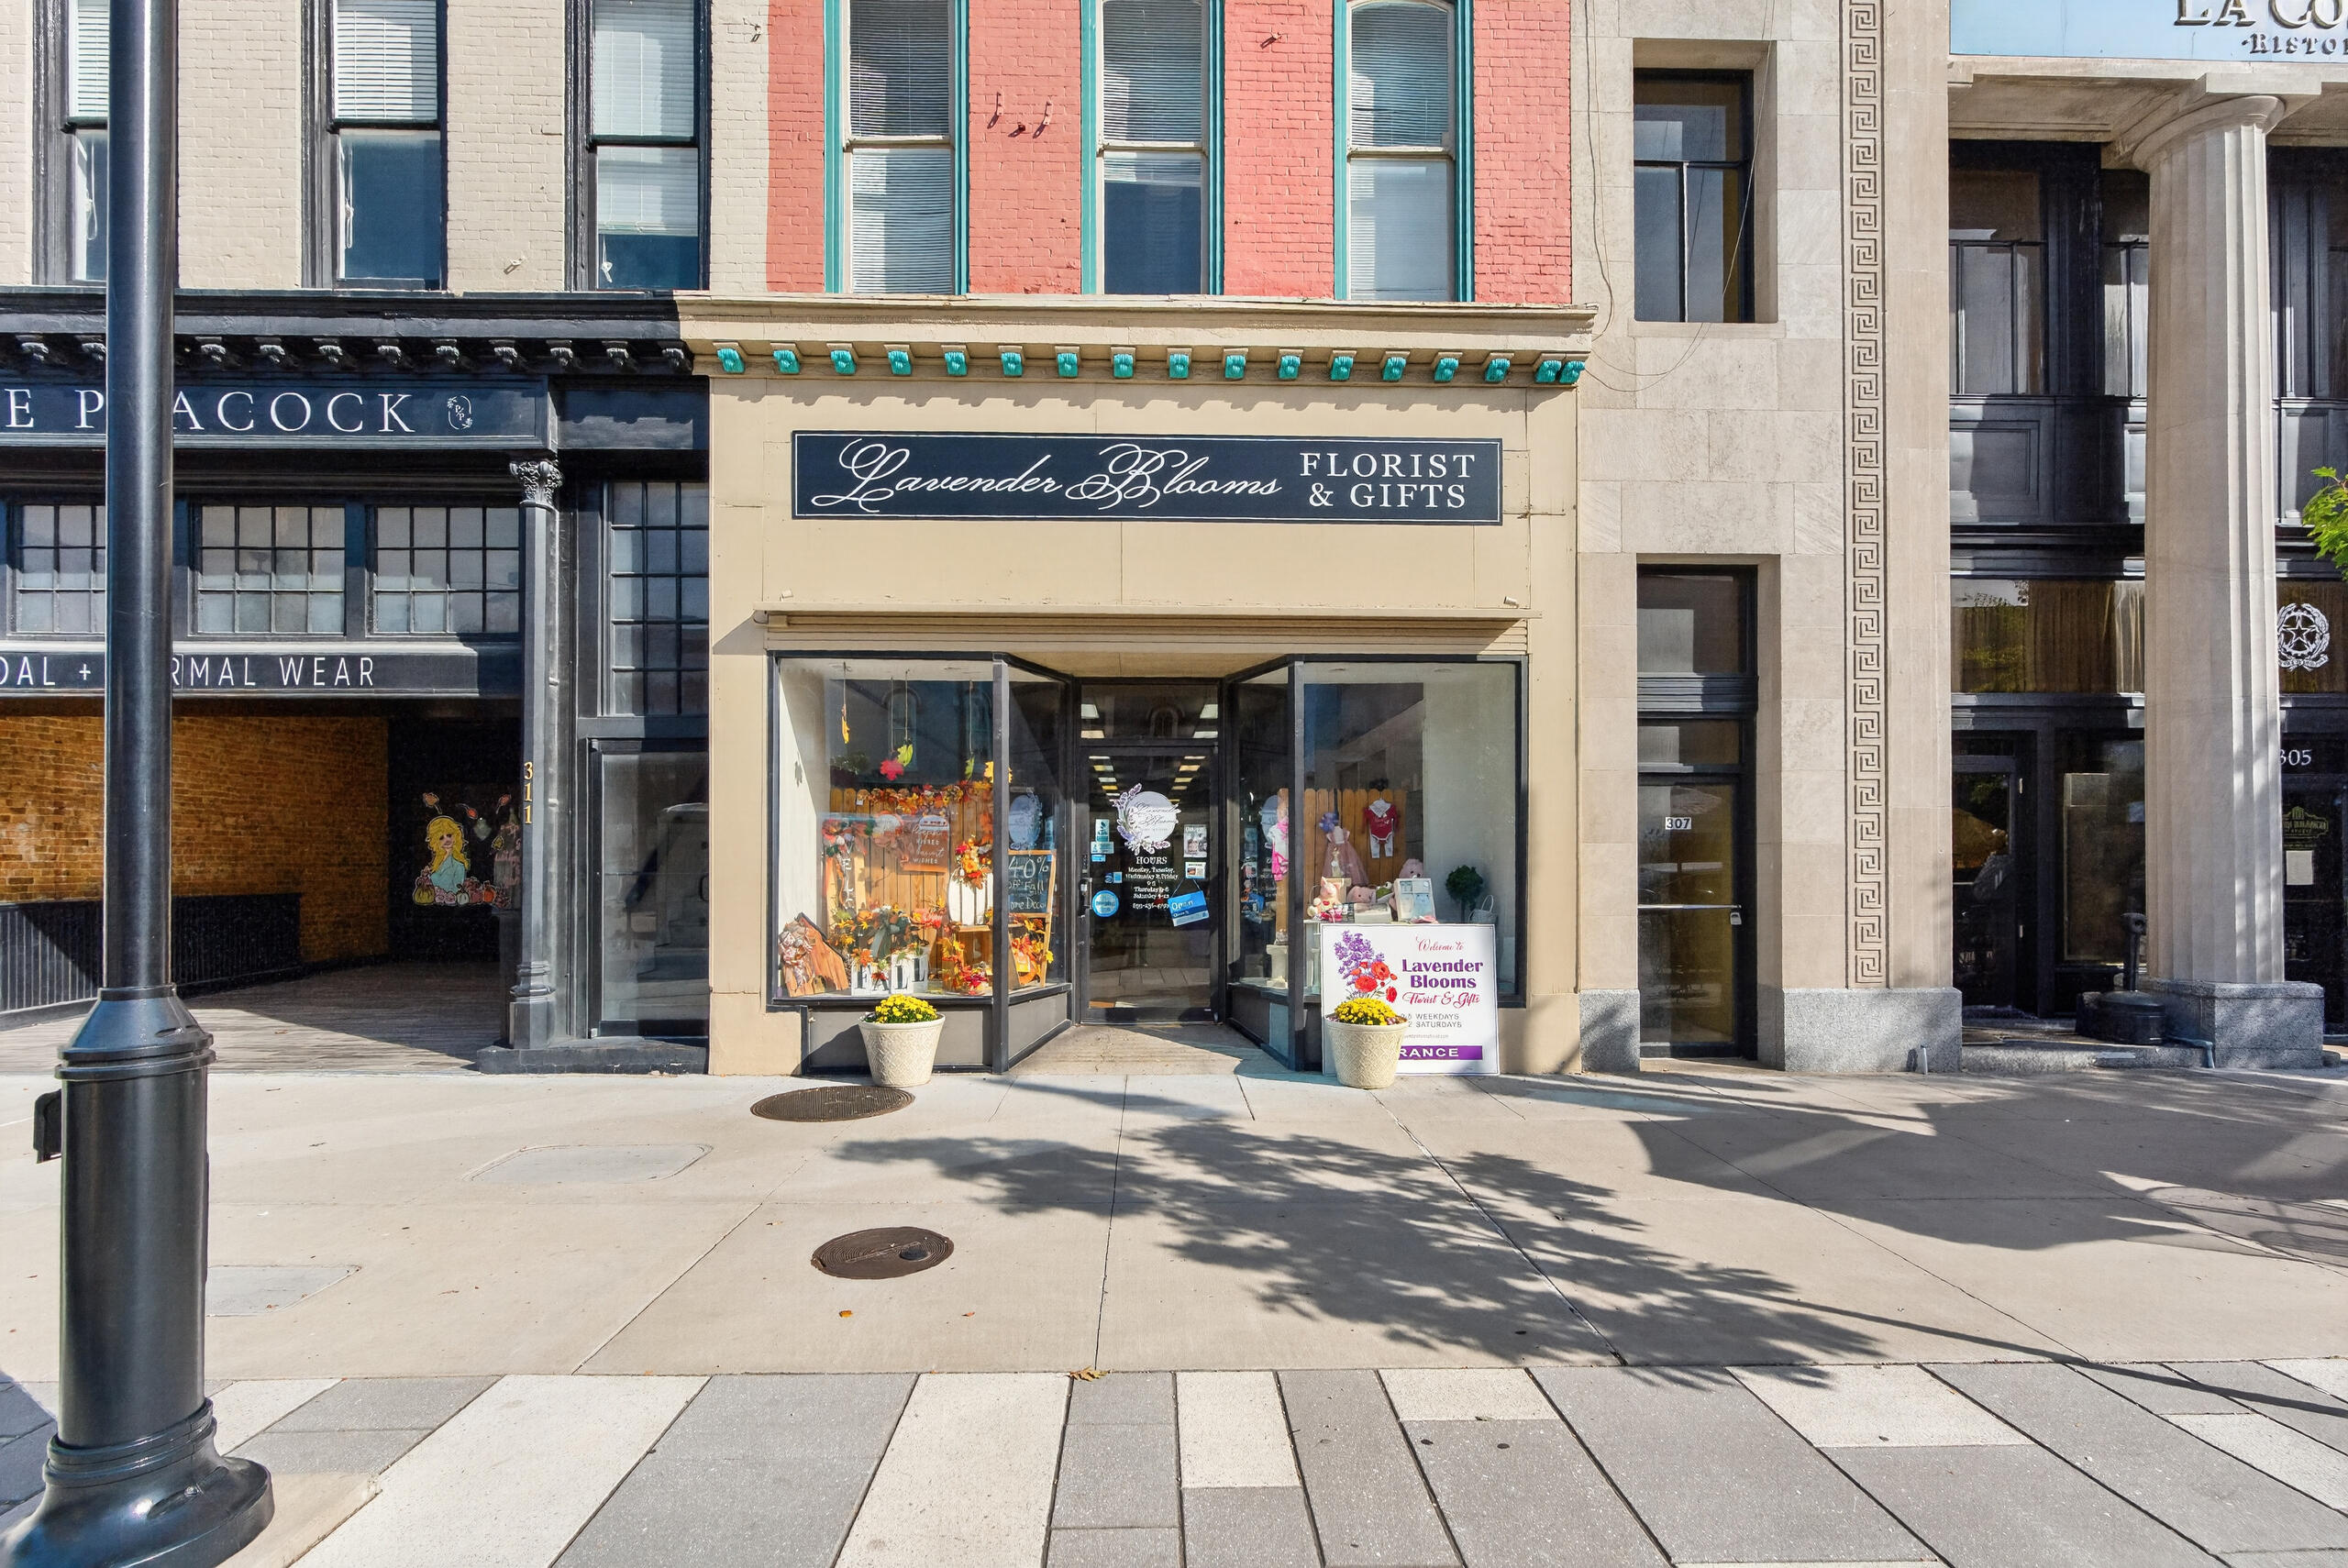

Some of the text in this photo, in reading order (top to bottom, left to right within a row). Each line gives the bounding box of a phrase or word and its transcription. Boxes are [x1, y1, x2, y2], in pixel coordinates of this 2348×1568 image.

[2268, 0, 2348, 29] CO
[2250, 33, 2348, 55] RISTO
[74, 390, 415, 433] PACOCK
[1300, 452, 1475, 478] FLORIST
[812, 438, 1282, 513] Lavender Blooms
[1309, 482, 1466, 508] & GIFTS
[172, 657, 257, 686] RMAL
[280, 657, 374, 687] WEAR
[2280, 749, 2312, 766] 305
[524, 761, 533, 824] 311
[1667, 818, 1690, 829] 307
[1009, 856, 1049, 878] 40%
[1135, 856, 1168, 865] HOURS
[1010, 901, 1024, 911] ome
[1416, 936, 1453, 952] Welcome
[1402, 959, 1483, 973] Lavender
[1411, 975, 1477, 988] Blooms
[1402, 991, 1441, 1005] Florist
[1453, 992, 1480, 1009] Gifts
[1400, 1048, 1459, 1057] RANCE
